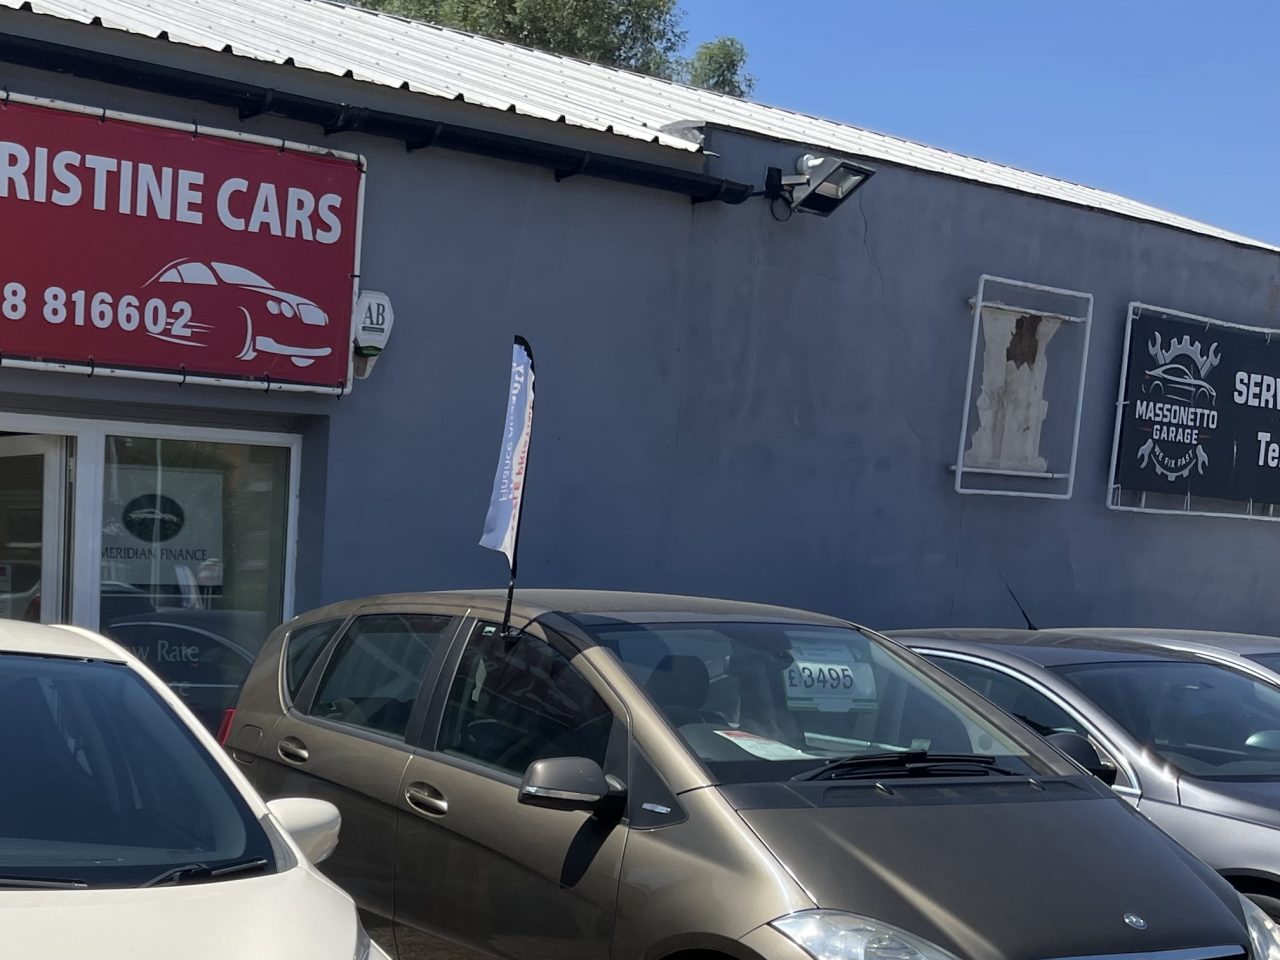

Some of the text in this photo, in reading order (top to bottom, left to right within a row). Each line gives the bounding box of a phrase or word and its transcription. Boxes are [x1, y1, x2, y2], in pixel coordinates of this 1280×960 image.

[216, 176, 344, 245] CARS
[42, 285, 193, 338] 816602
[362, 302, 386, 327] AB
[1233, 370, 1280, 411] SER
[1135, 399, 1218, 430] MASSONETTO
[1152, 424, 1199, 445] GARAGE
[1257, 431, 1280, 468] Te
[101, 546, 208, 561] MERIDIAN FINANCE
[157, 639, 200, 662] Rate
[788, 666, 854, 690] £3495
